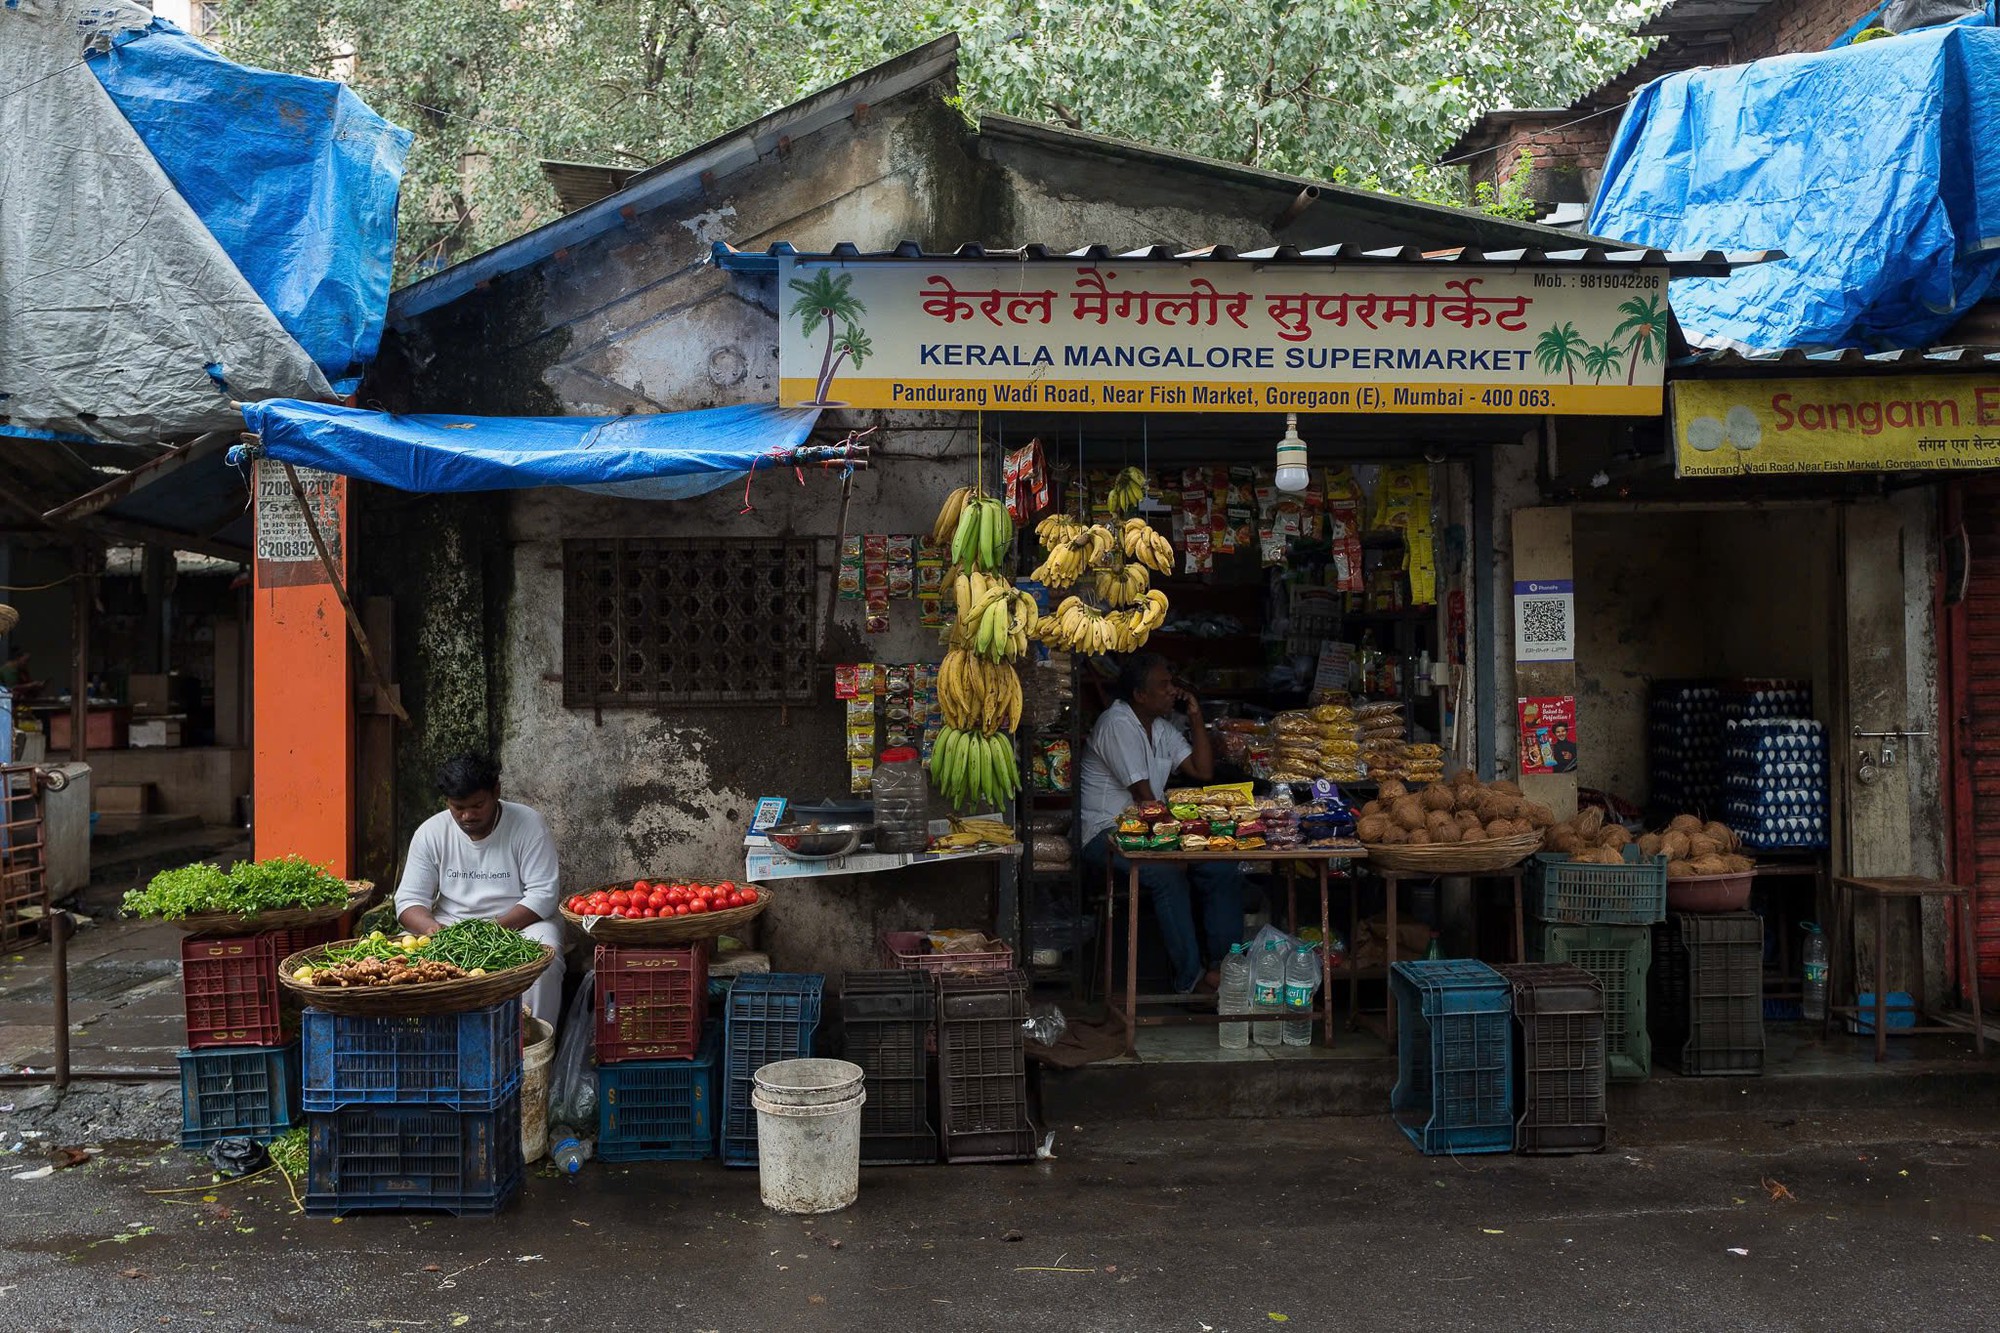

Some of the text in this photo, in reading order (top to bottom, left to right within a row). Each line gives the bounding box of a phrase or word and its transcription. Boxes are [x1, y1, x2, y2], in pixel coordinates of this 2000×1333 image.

[1534, 273, 1566, 288] Mob.
[1580, 274, 1660, 289] 9819042286
[920, 267, 1533, 341] केरल मैंगलोर सुपरमार्केट
[920, 344, 1532, 371] KERALA MANGALORE SUPERMARKET
[893, 383, 987, 406] Pandurang
[994, 384, 1038, 403] Wadi
[1044, 385, 1095, 405] Road,
[1103, 386, 1144, 404] Near
[1151, 386, 1185, 404] Fish
[1193, 387, 1258, 406] Market,
[1266, 387, 1349, 408] Goregaon
[1356, 388, 1386, 409] (E),
[1393, 388, 1463, 406] Mumbai
[1482, 389, 1513, 407] 400
[1519, 390, 1556, 407] 063.
[1771, 392, 1960, 435] Sangam
[1918, 436, 1947, 451] संगम
[1950, 439, 1970, 453] एग
[1685, 464, 1740, 476] Pandurang
[1742, 462, 1768, 473] Wadi
[1824, 460, 1844, 471] Fish
[1847, 460, 1883, 470] Market,
[1886, 459, 1933, 470] Goregaon
[1936, 458, 1950, 468] (E)
